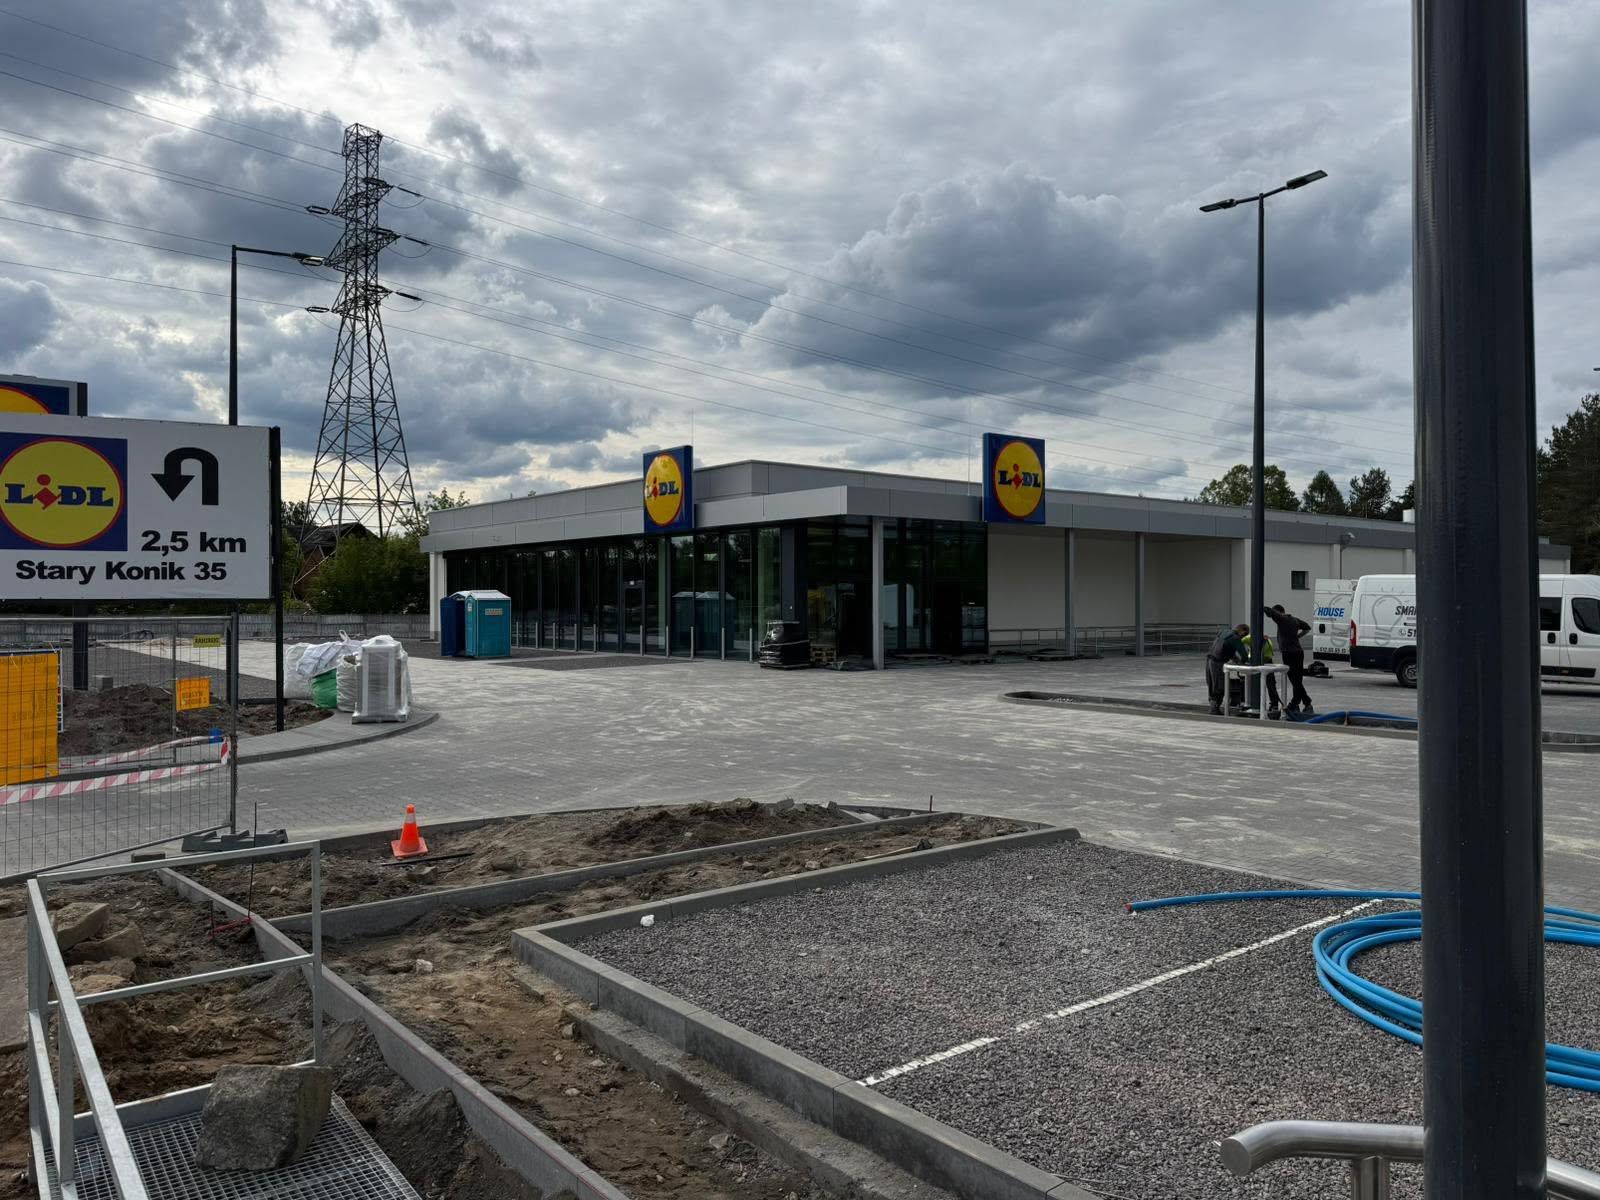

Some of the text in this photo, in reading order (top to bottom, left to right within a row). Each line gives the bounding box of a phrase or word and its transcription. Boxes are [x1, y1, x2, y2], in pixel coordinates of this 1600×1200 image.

[141, 530, 247, 556] 2,5 km
[15, 559, 228, 585] Stary Konik 35
[1317, 607, 1345, 618] HOUSE
